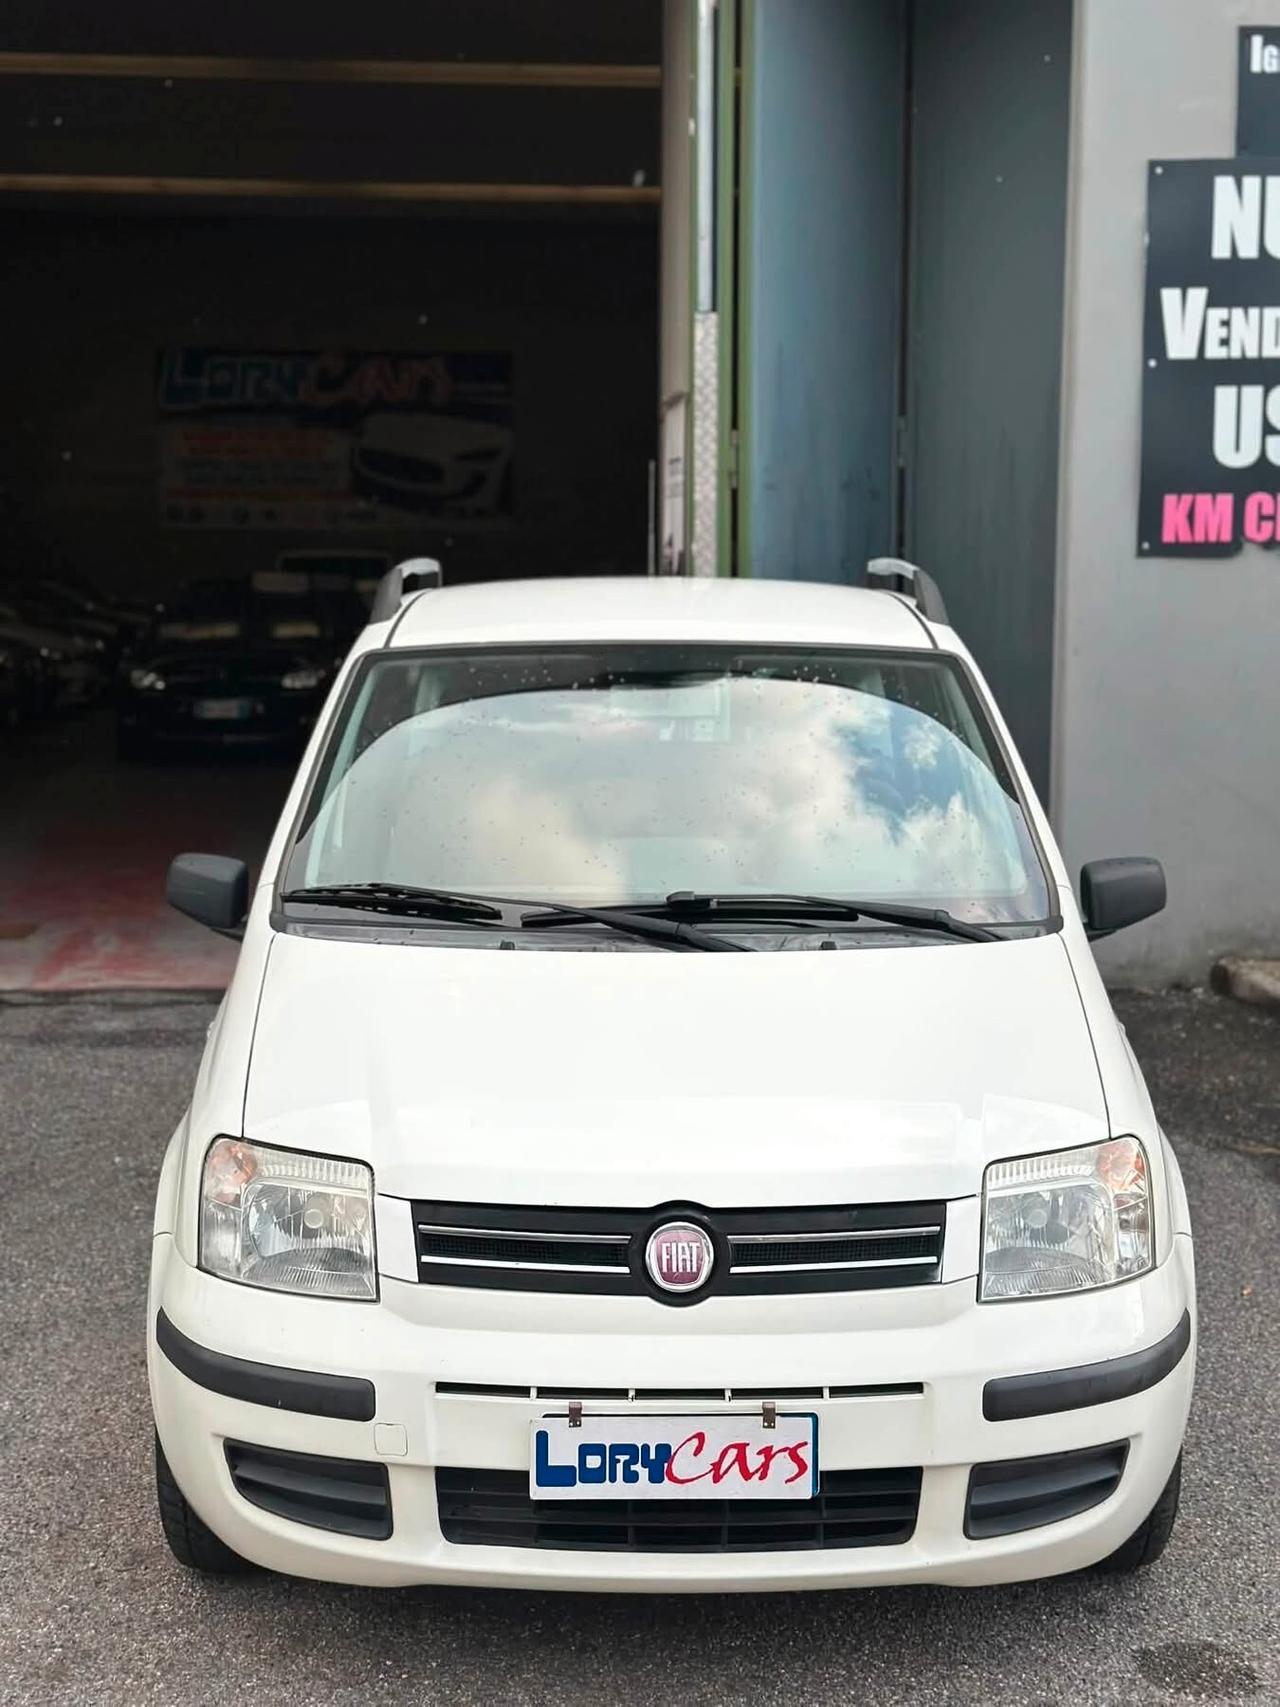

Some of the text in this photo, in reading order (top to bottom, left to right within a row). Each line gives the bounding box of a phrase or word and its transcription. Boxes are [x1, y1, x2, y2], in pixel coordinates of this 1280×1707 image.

[1161, 491, 1280, 543] KM C
[661, 1241, 700, 1273] FIAT
